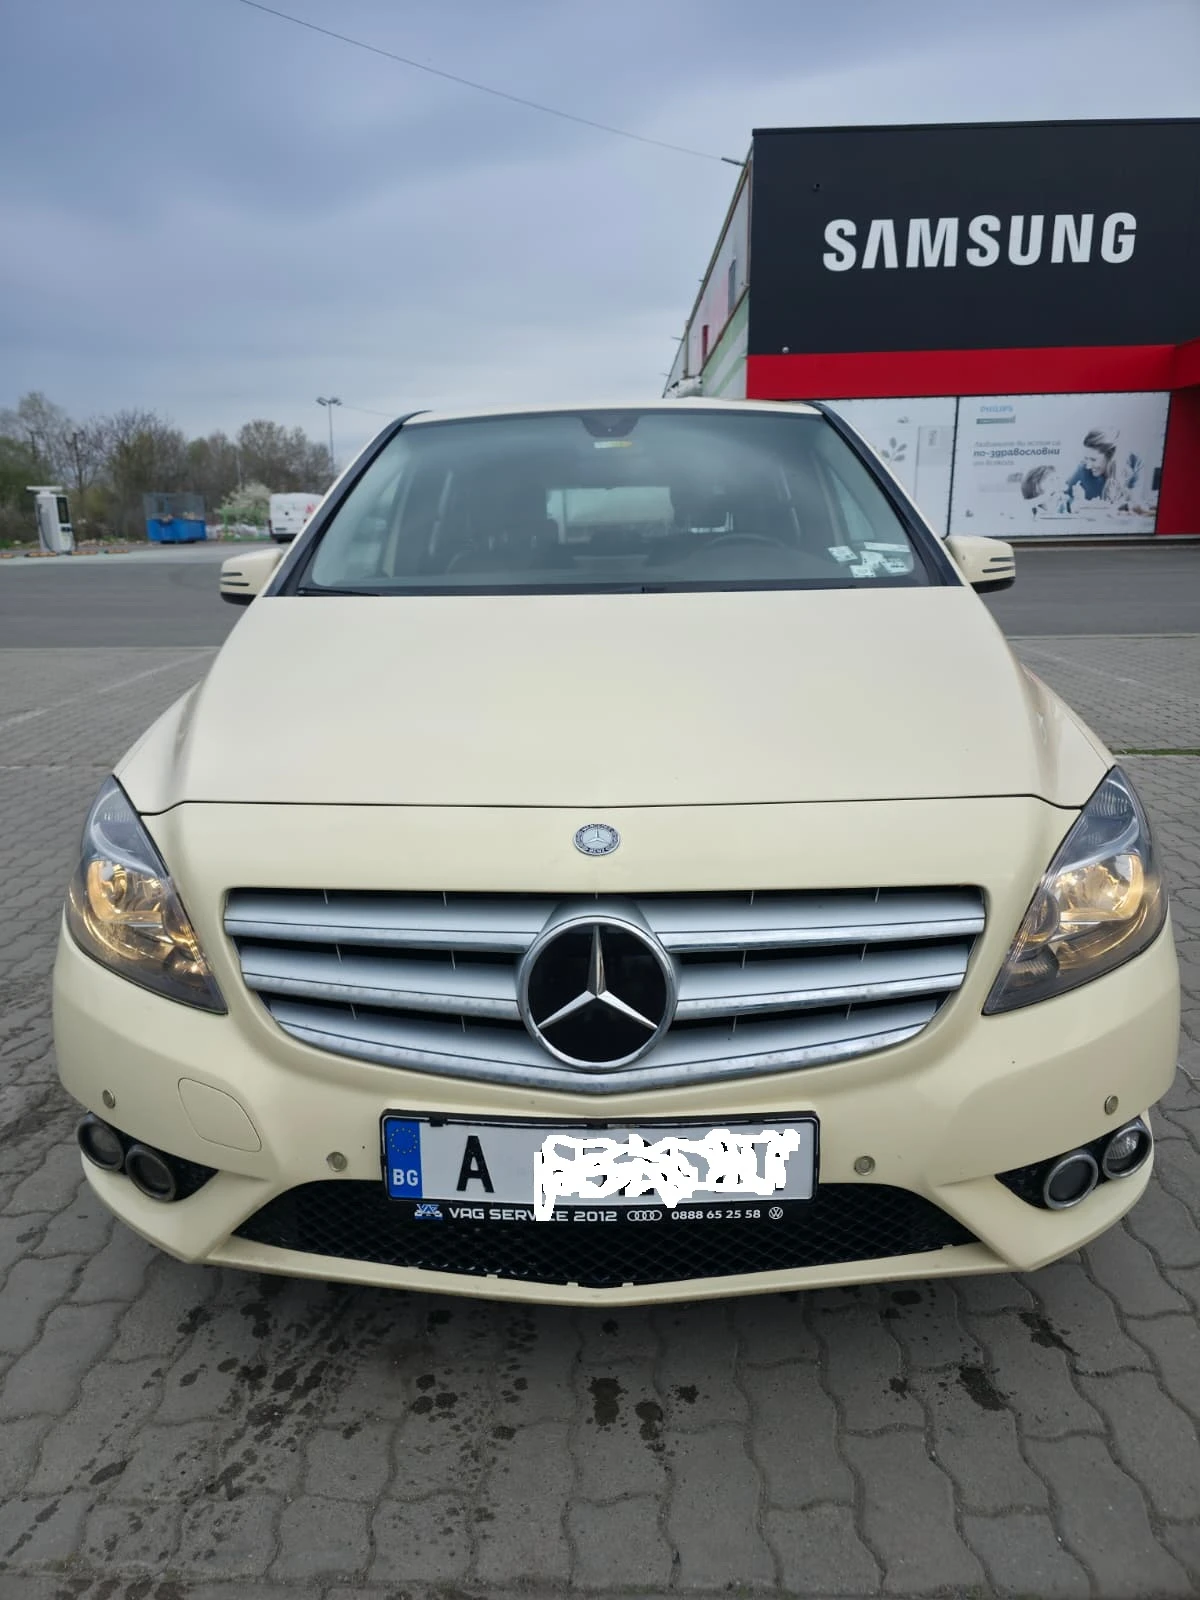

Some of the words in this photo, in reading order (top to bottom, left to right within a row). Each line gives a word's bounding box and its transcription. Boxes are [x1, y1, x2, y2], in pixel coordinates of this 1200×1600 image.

[822, 212, 1137, 272] SAMSUNG
[392, 1168, 419, 1187] BG
[449, 1207, 485, 1220] VAG
[573, 1210, 617, 1222] 2012
[671, 1210, 704, 1220] 0888
[706, 1209, 723, 1220] 65
[725, 1209, 742, 1219] 25
[744, 1209, 761, 1219] 58
